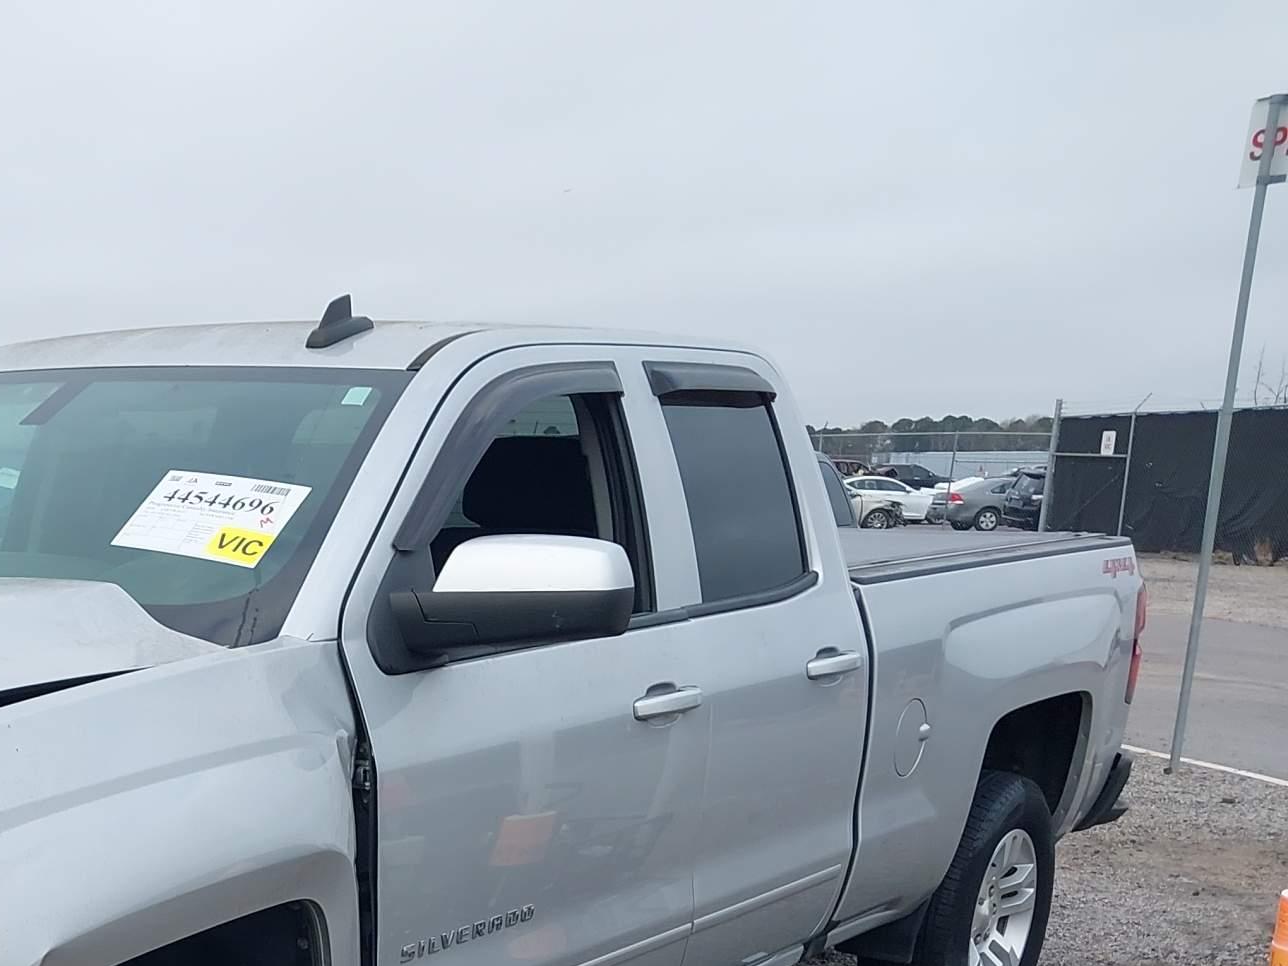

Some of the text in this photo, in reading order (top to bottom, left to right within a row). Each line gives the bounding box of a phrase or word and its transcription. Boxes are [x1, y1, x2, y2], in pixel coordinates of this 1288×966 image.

[1250, 126, 1288, 162] SP
[164, 489, 280, 515] 44544696
[218, 533, 263, 556] VIC
[400, 904, 535, 964] SILVERADO
